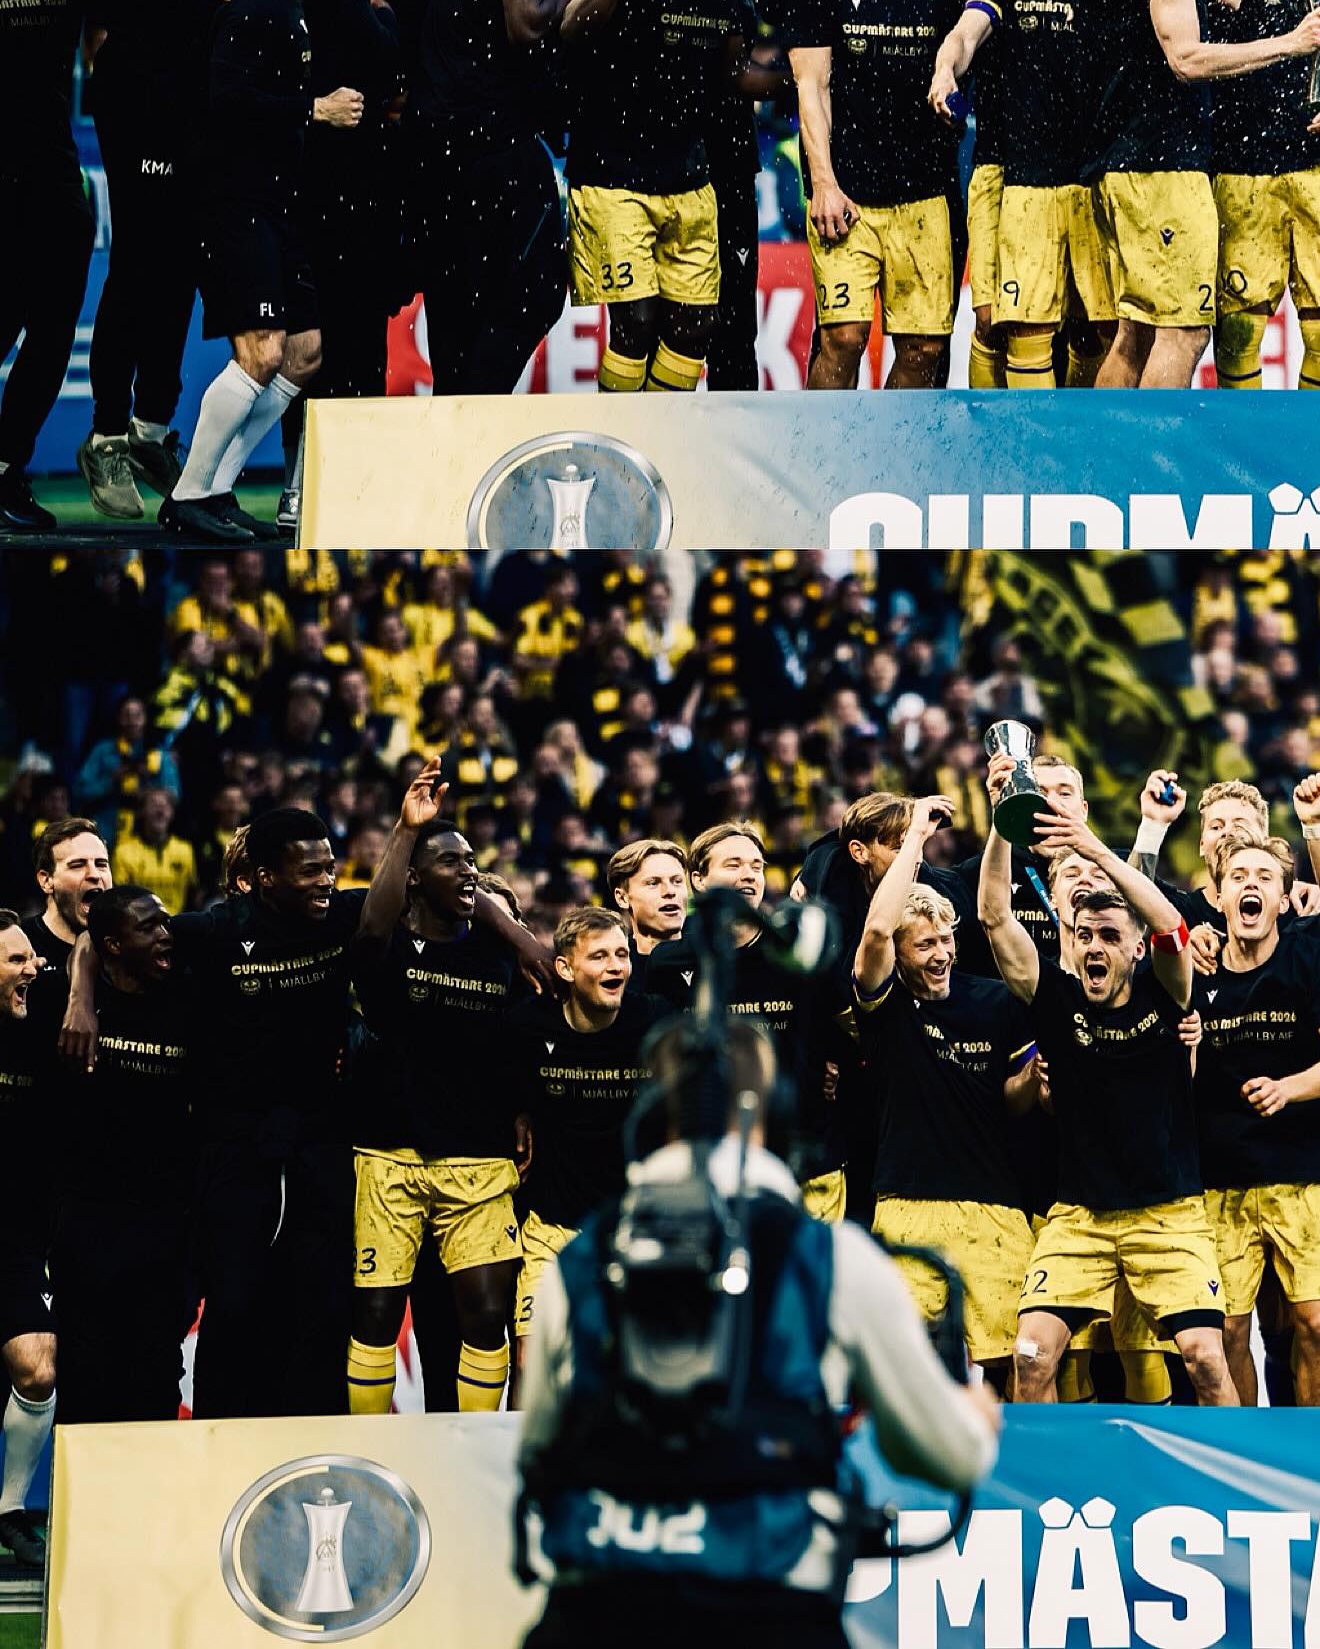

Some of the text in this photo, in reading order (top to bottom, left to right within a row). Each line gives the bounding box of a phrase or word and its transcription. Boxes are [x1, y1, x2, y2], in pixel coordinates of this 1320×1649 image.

[840, 23, 936, 38] CUPMÄSTARE 202
[141, 158, 174, 176] KMA
[601, 262, 635, 291] 33
[819, 282, 850, 311] 23
[1002, 280, 1020, 307] 9
[1197, 283, 1215, 312] 2
[259, 302, 275, 317] FL
[230, 957, 315, 976] CUPMÄSTARE
[404, 966, 506, 996] CUPMÄSTARE 202
[762, 1000, 793, 1015] 2026
[1268, 1009, 1298, 1024] 2026
[98, 1035, 161, 1056] MÄSTARE
[960, 1041, 992, 1055] 2026
[538, 1065, 621, 1081] CUPMÄSTARE
